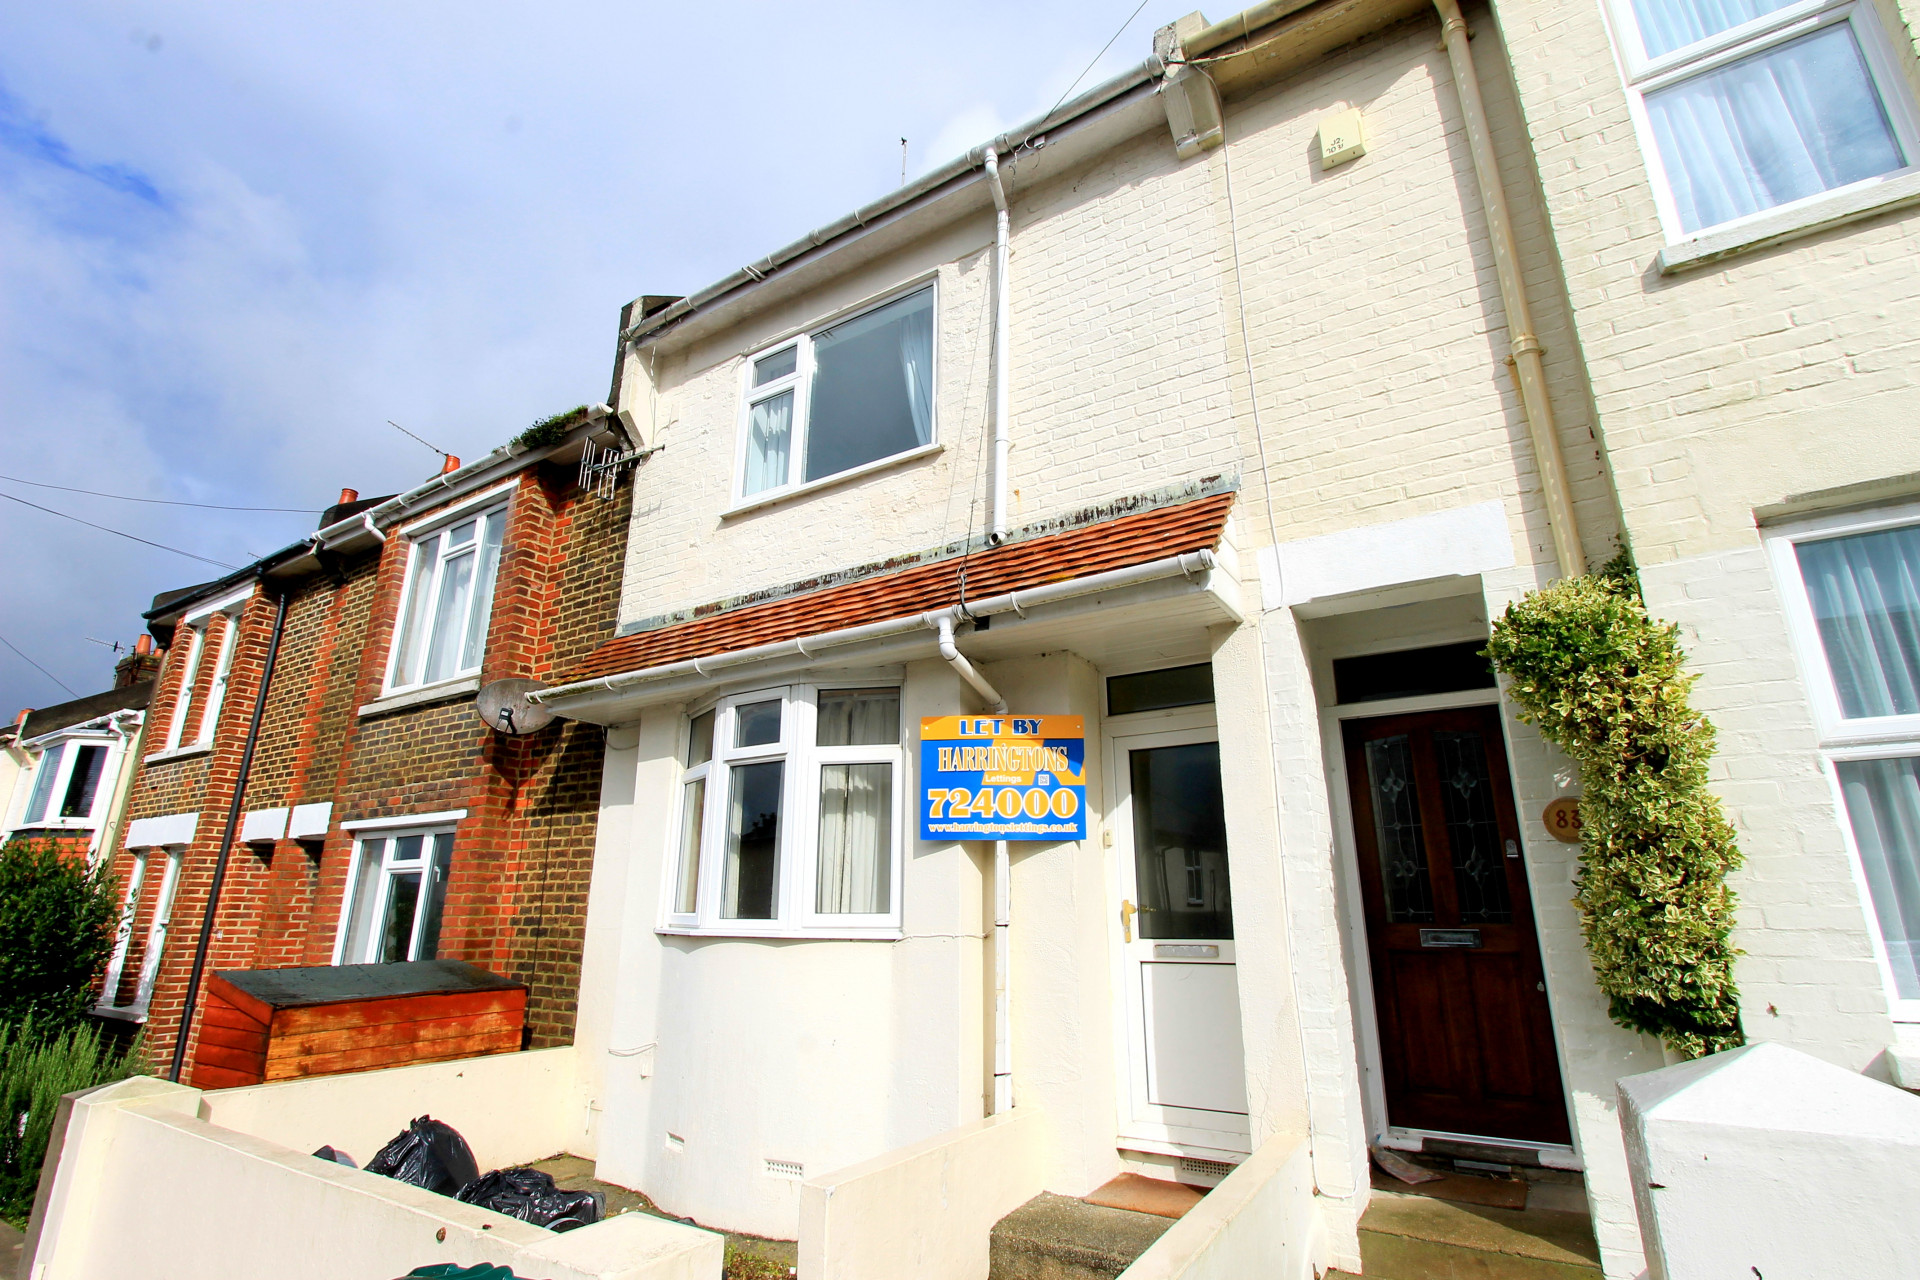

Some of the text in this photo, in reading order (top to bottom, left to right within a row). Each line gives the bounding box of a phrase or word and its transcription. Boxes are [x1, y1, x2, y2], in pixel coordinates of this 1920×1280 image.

[959, 718, 1043, 736] LET BY
[937, 746, 1069, 772] HARRINGTONS
[985, 774, 1022, 784] Lettings
[927, 787, 1079, 819] 724000
[928, 822, 1078, 834] www.harringtonslettings.co.uk
[1556, 809, 1582, 829] 83
